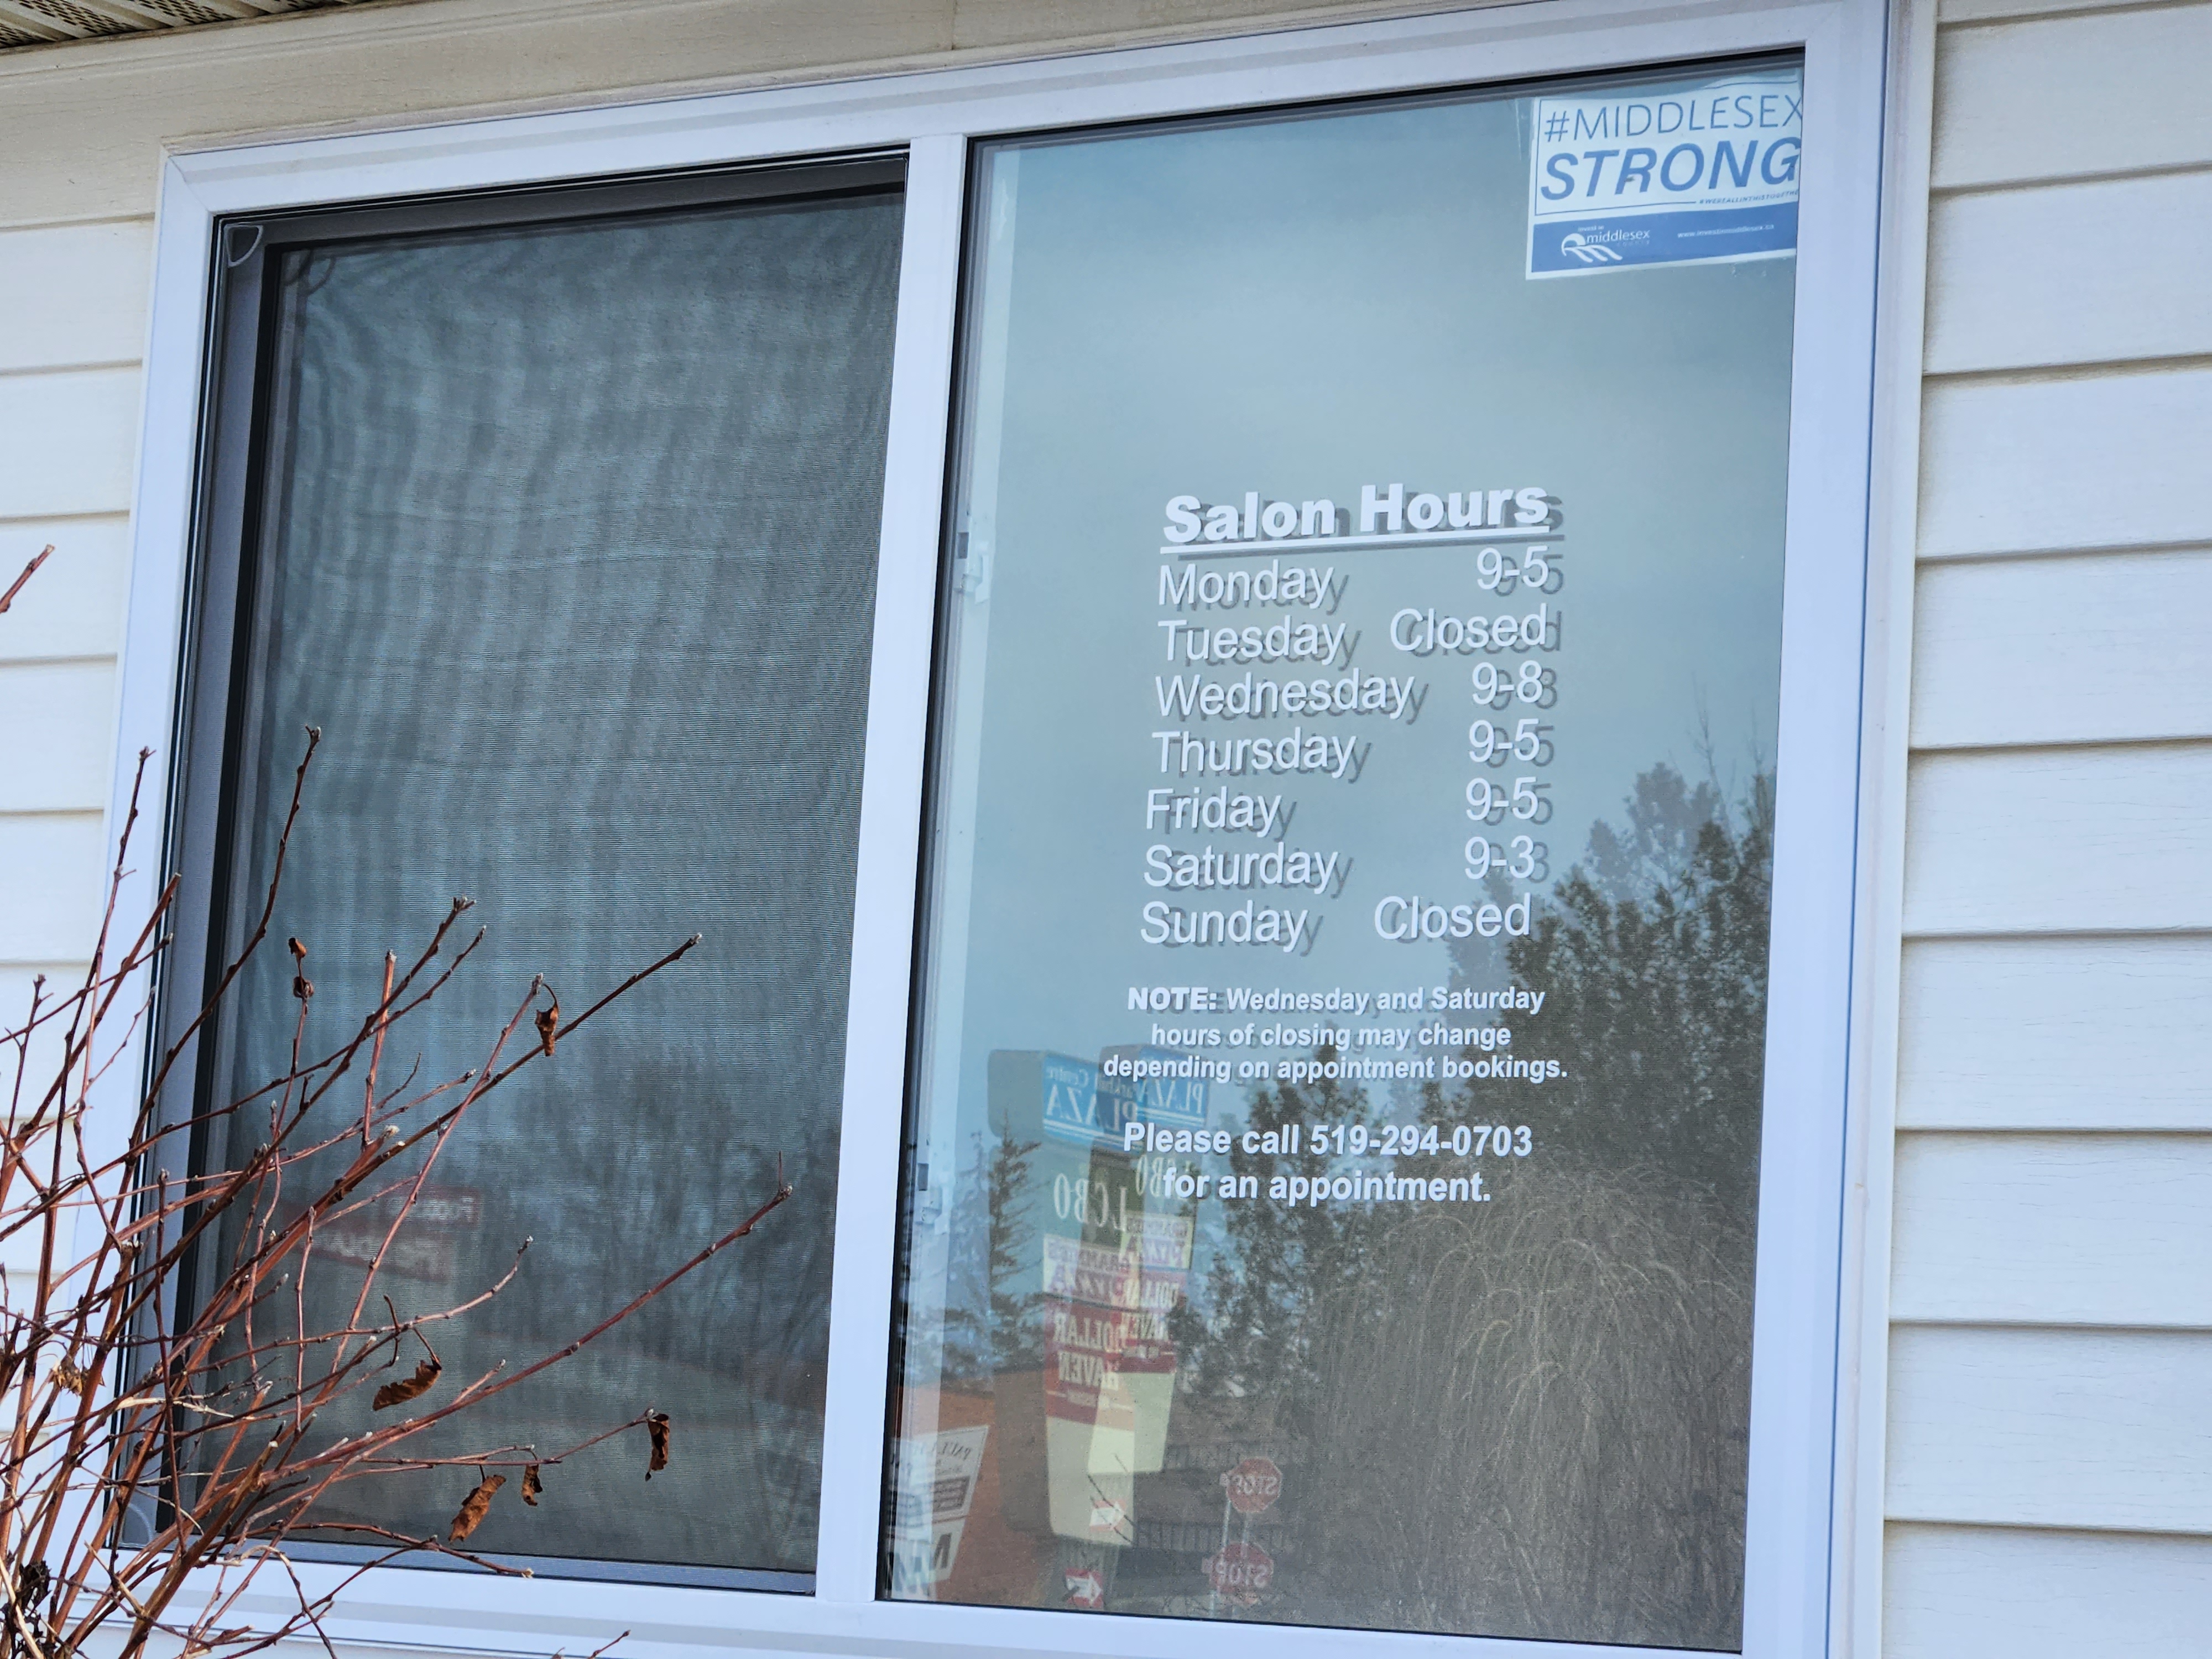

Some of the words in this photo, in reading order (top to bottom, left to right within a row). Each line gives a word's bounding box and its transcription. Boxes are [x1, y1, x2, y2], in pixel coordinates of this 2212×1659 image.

[1544, 94, 1802, 142] #MIDDLESEX
[1541, 137, 1802, 201] STRONG
[1587, 229, 1651, 244] middlesex
[1163, 492, 1335, 543] Salon
[1360, 483, 1550, 532] Hours
[1159, 559, 1333, 609] Monday
[1477, 545, 1548, 589] 9-5
[1157, 614, 1346, 666] Tuesday
[1390, 603, 1546, 651] Closed
[1155, 667, 1415, 719] Wednesday
[1472, 660, 1542, 705] 9-8
[1151, 726, 1356, 778] Thursday
[1469, 718, 1539, 763] 9-5
[1146, 786, 1281, 837] Friday
[1466, 776, 1537, 821] 9-5
[1144, 842, 1338, 894] Saturday
[1465, 835, 1534, 879] 9-3
[1141, 900, 1308, 952] Sunday
[1374, 892, 1530, 940] Closed
[1128, 987, 1217, 1010] NOTE:
[1227, 987, 1369, 1015] Wednesday
[1377, 987, 1423, 1009] and
[1431, 986, 1545, 1014] Saturday
[1152, 1023, 1220, 1045] hours
[1229, 1022, 1255, 1045] of
[1261, 1023, 1350, 1051] closing
[1359, 1028, 1410, 1051] may
[1418, 1022, 1510, 1048] change
[1104, 1055, 1231, 1083] depending
[1239, 1061, 1269, 1078] on
[1277, 1056, 1434, 1083] appointment
[1442, 1055, 1567, 1082] bookings.
[1124, 1122, 1230, 1152] Please
[1242, 1124, 1298, 1154] call
[1311, 1125, 1531, 1156] 519-294-0703
[1163, 1167, 1210, 1197] for
[1220, 1173, 1259, 1198] an
[1269, 1170, 1490, 1207] appointment.
